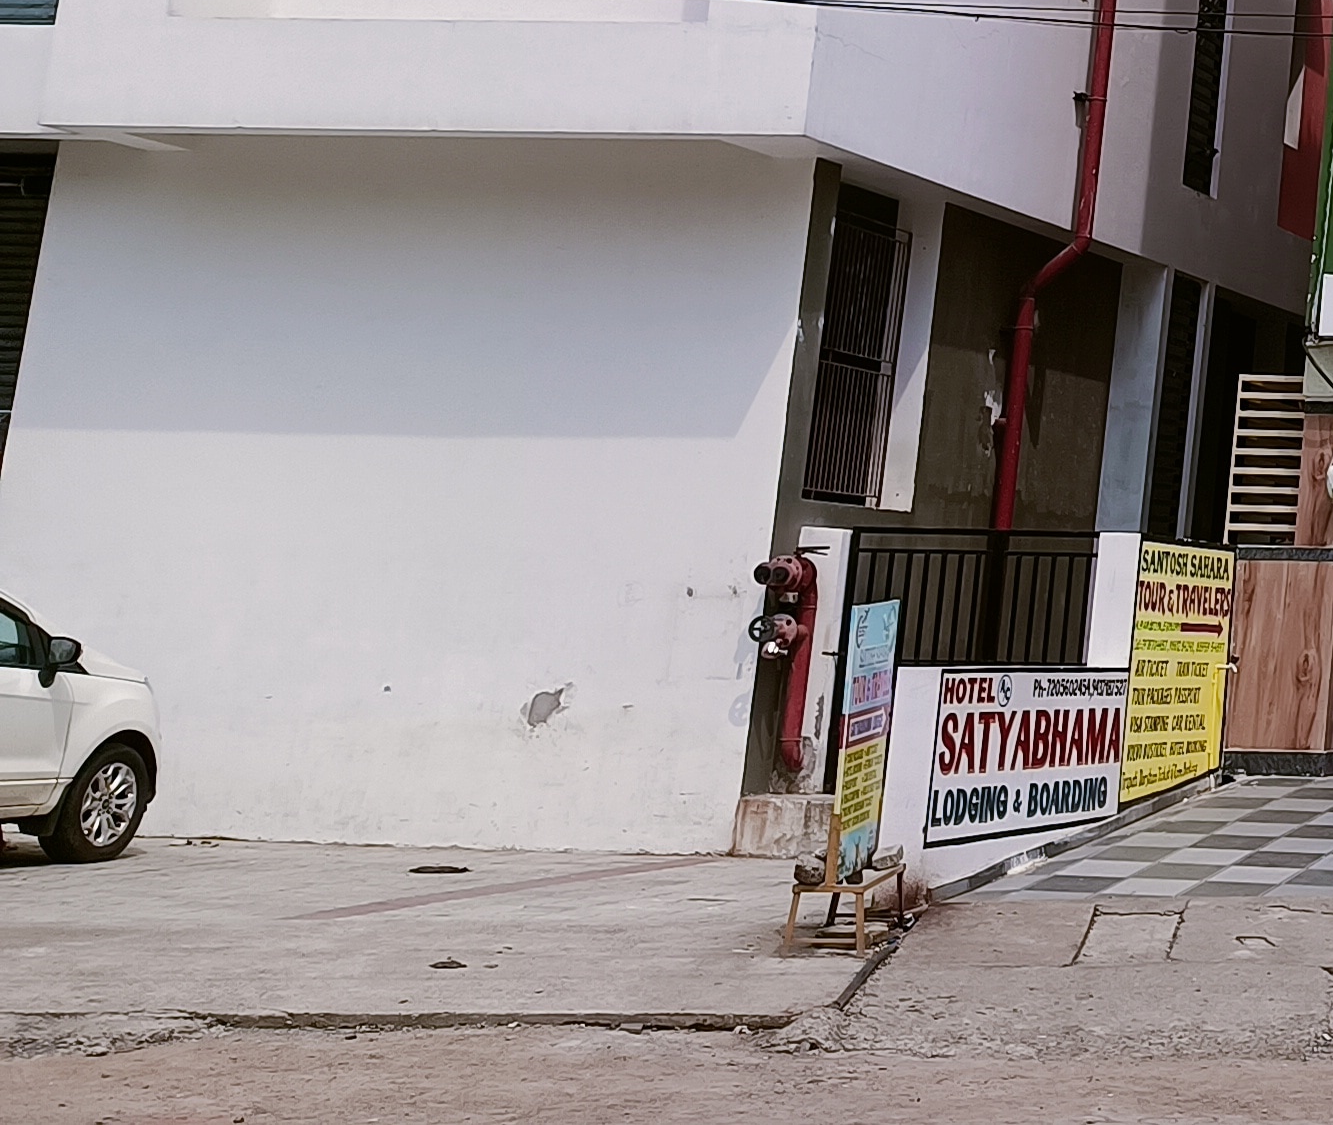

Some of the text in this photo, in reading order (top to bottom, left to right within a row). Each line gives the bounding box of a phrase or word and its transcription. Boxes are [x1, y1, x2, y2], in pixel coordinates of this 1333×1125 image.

[1141, 549, 1230, 582] SANTOSH SAHARA
[1138, 580, 1232, 619] TOUR & TRAVELERS
[943, 678, 996, 704] HOTEL
[938, 707, 1121, 775] SATYABHAMA
[930, 785, 1008, 827] LODGING
[1013, 788, 1022, 814] &
[1027, 776, 1108, 817] BOARDING
